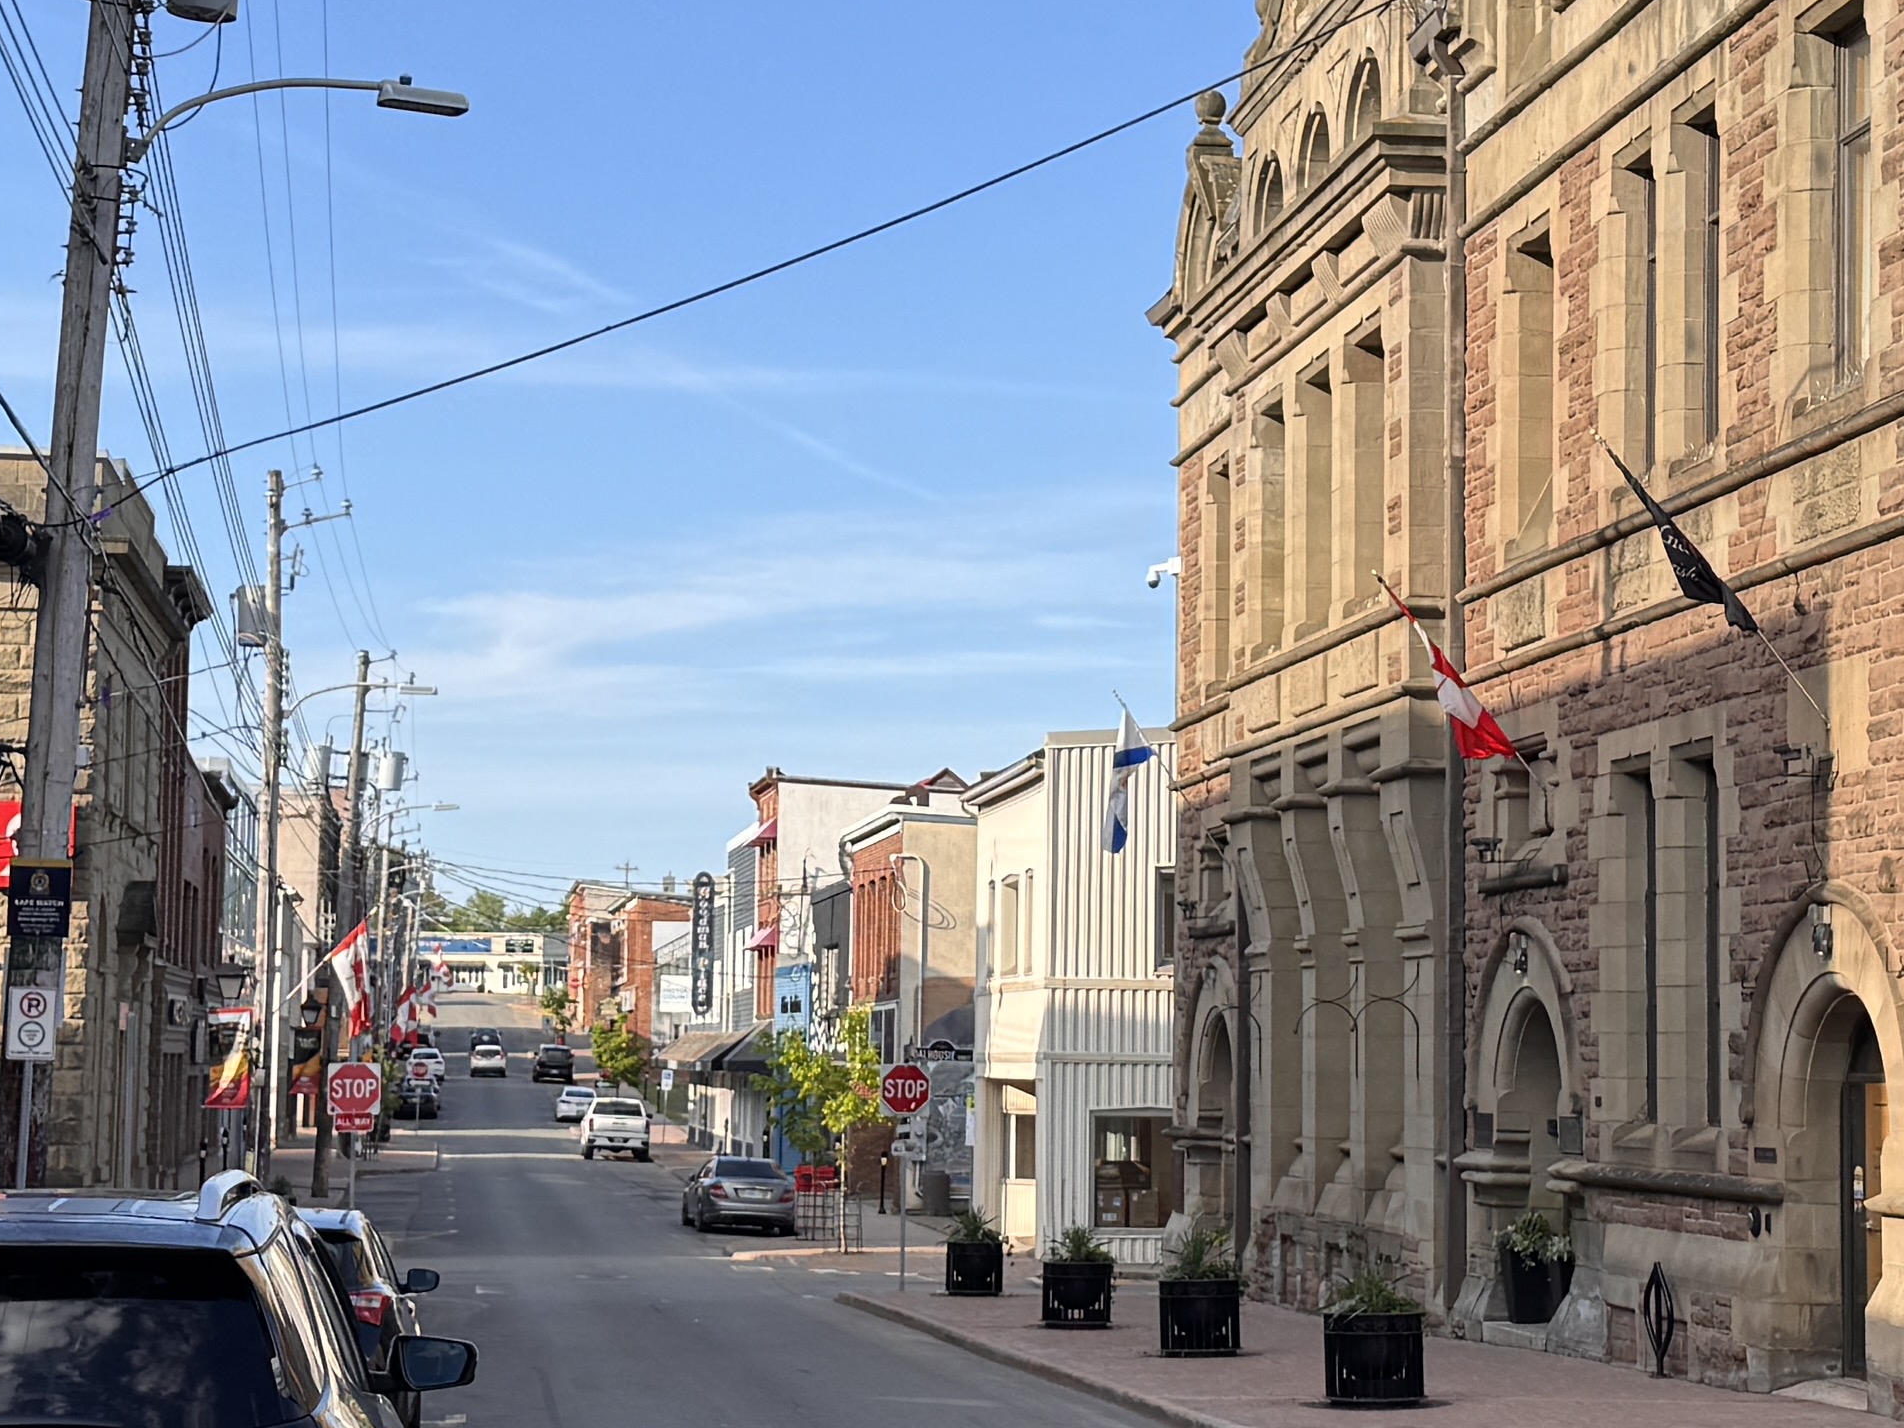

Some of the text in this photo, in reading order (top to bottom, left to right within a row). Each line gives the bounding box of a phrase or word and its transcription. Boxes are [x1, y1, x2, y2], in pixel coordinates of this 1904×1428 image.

[331, 1078, 377, 1099] STOP
[884, 1078, 927, 1100] STOP
[336, 1117, 371, 1126] ALL WAY
